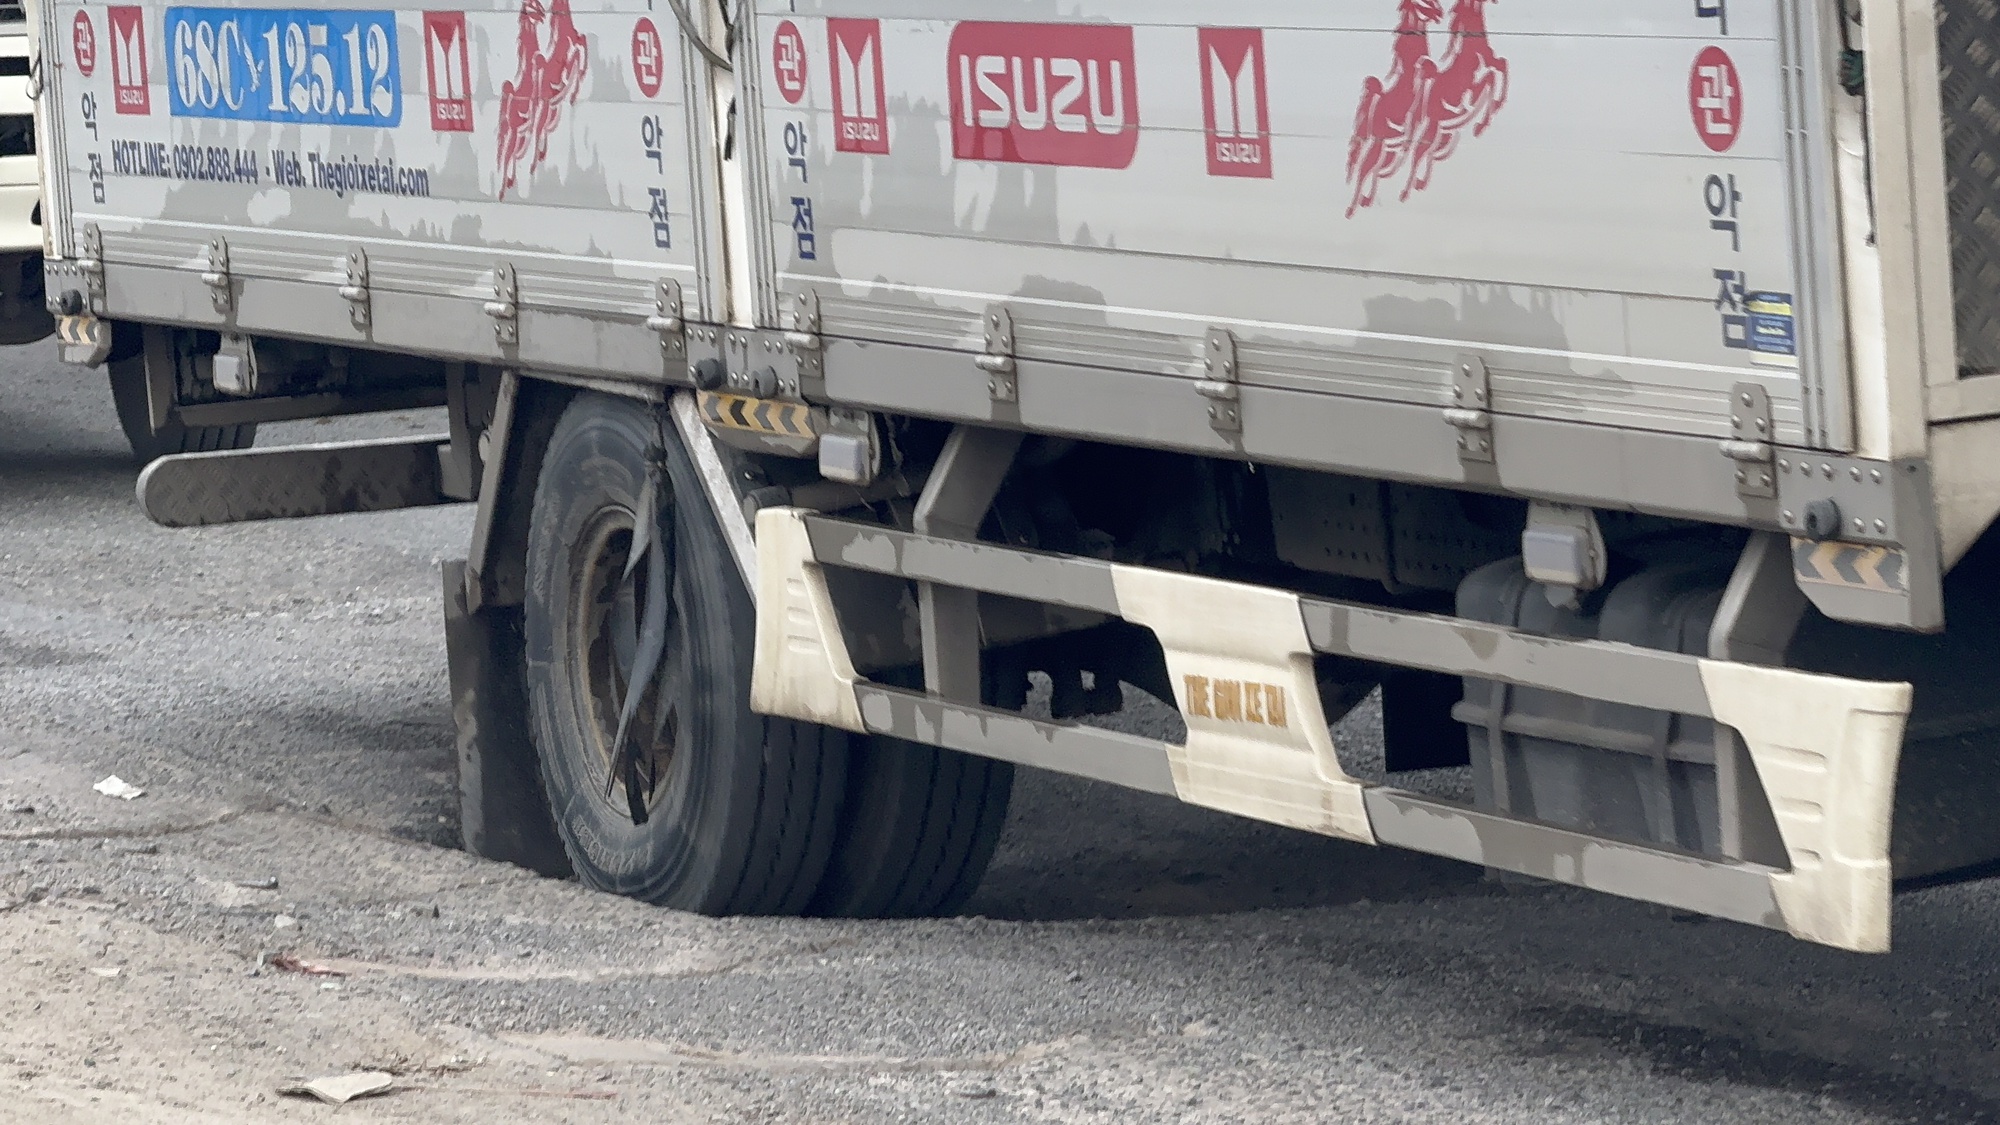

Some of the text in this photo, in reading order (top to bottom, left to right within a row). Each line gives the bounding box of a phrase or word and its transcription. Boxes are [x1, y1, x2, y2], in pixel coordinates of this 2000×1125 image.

[119, 88, 145, 106] ISUZU
[958, 54, 1124, 135] ISUZU
[435, 102, 467, 120] ISUZU
[842, 121, 880, 142] ISUZU
[1215, 141, 1262, 165] ISUZU
[111, 138, 172, 179] HOTLINE:
[173, 143, 258, 185] 0902.888.444
[307, 151, 430, 199] Thegioixetai.com
